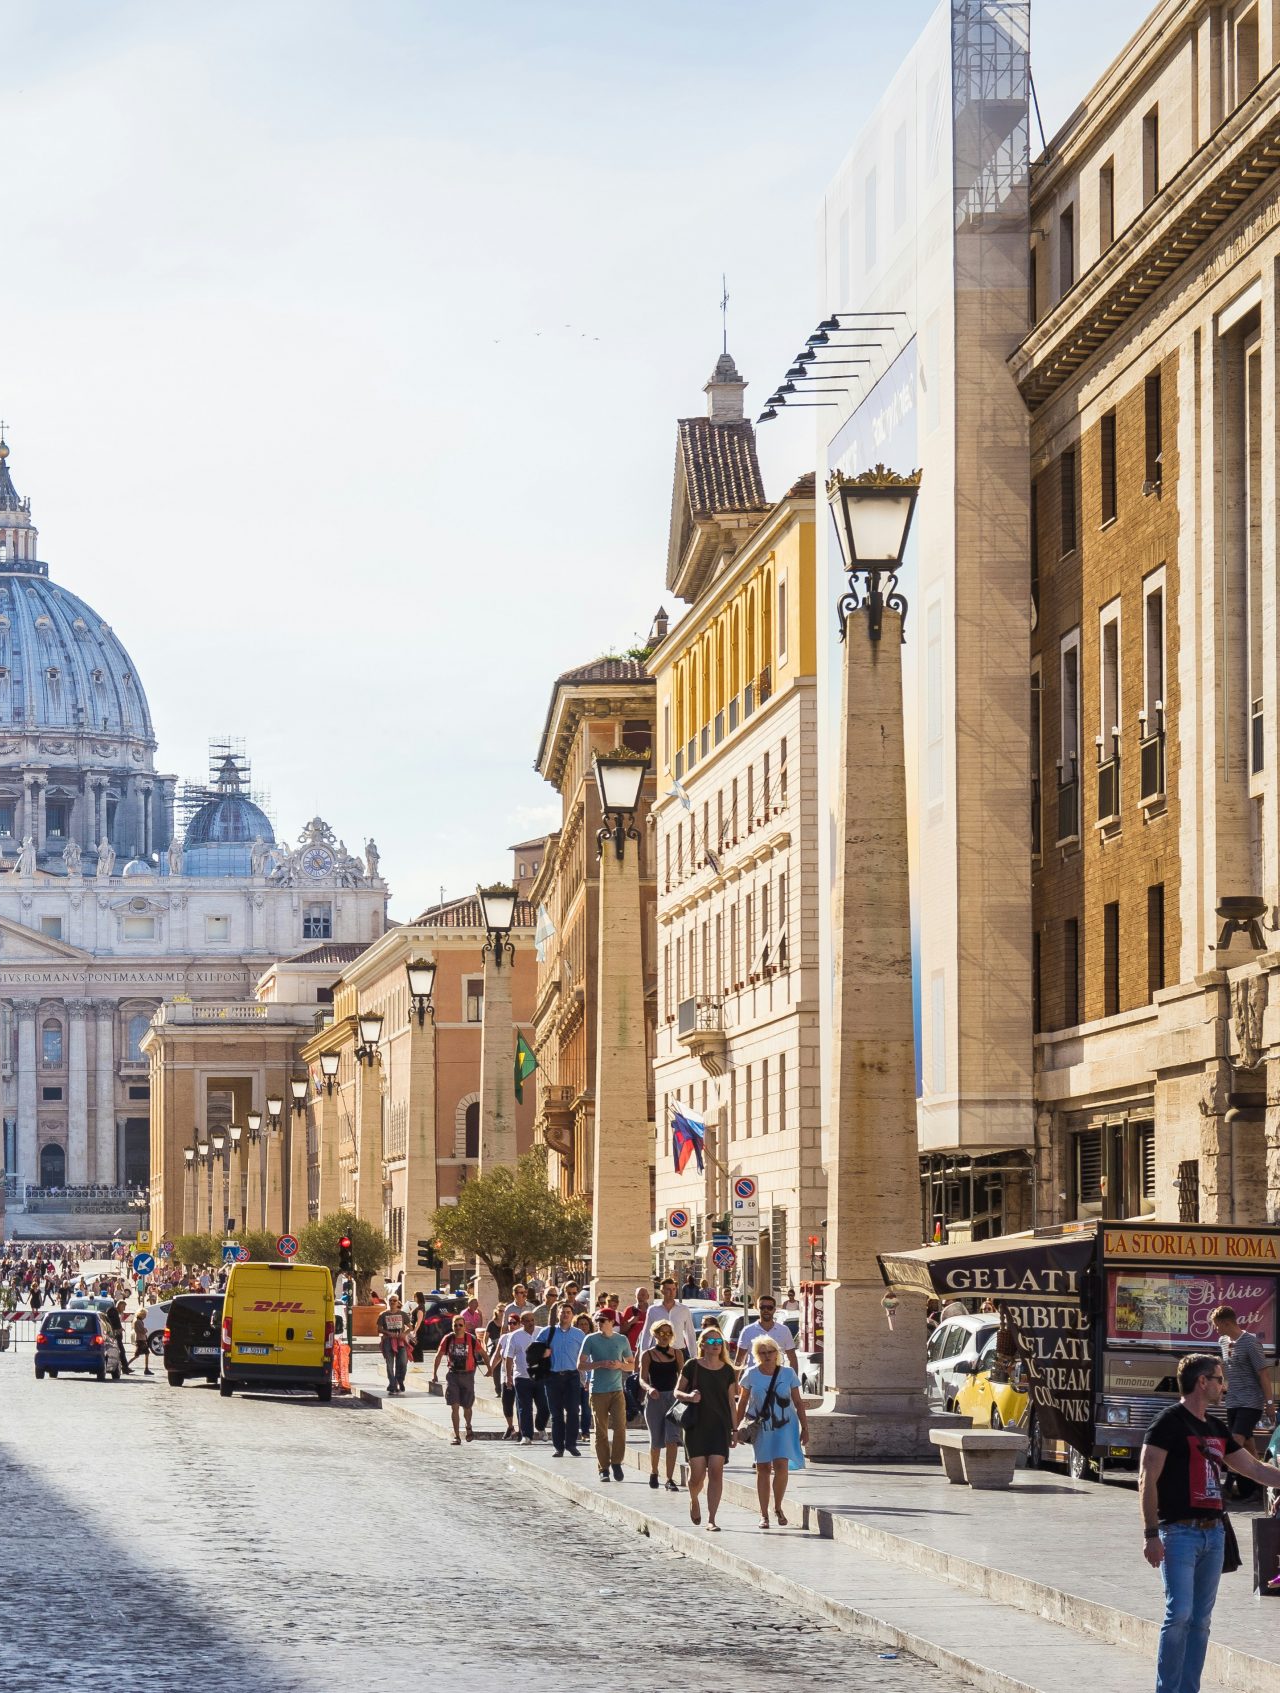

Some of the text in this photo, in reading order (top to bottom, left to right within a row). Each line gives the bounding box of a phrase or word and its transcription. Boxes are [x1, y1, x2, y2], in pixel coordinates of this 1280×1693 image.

[24, 973, 85, 982] ROMANVS
[1104, 1233, 1277, 1259] LA STORIA DI ROMA
[946, 1268, 1080, 1293] GELATI
[1187, 1279, 1266, 1306] Bibite
[252, 1301, 305, 1314] DHL
[1008, 1306, 1091, 1330] BIBITE
[1115, 1377, 1155, 1387] minonzio
